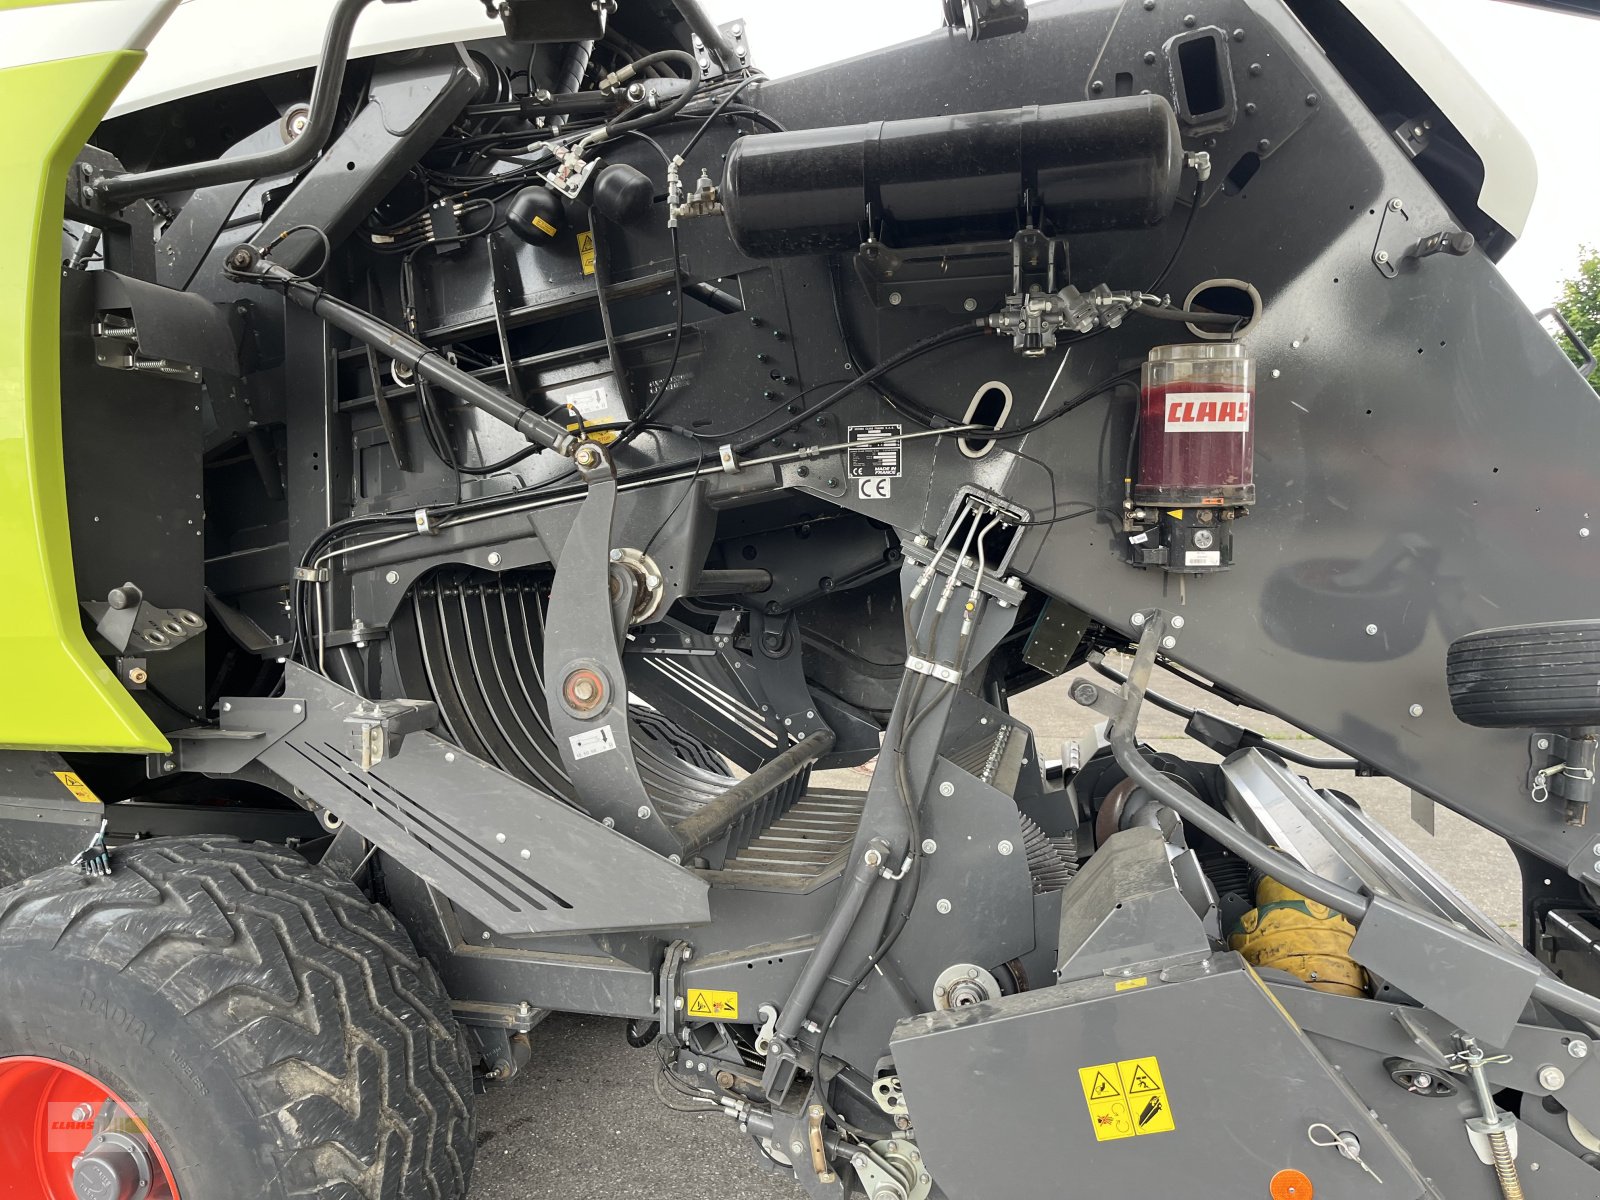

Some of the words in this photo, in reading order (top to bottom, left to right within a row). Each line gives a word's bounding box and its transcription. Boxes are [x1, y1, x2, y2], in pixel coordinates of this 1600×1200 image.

[1167, 402, 1249, 422] CLAAS
[861, 478, 887, 498] CE
[79, 986, 158, 1054] RADIAL
[170, 1049, 209, 1096] TUBELESS
